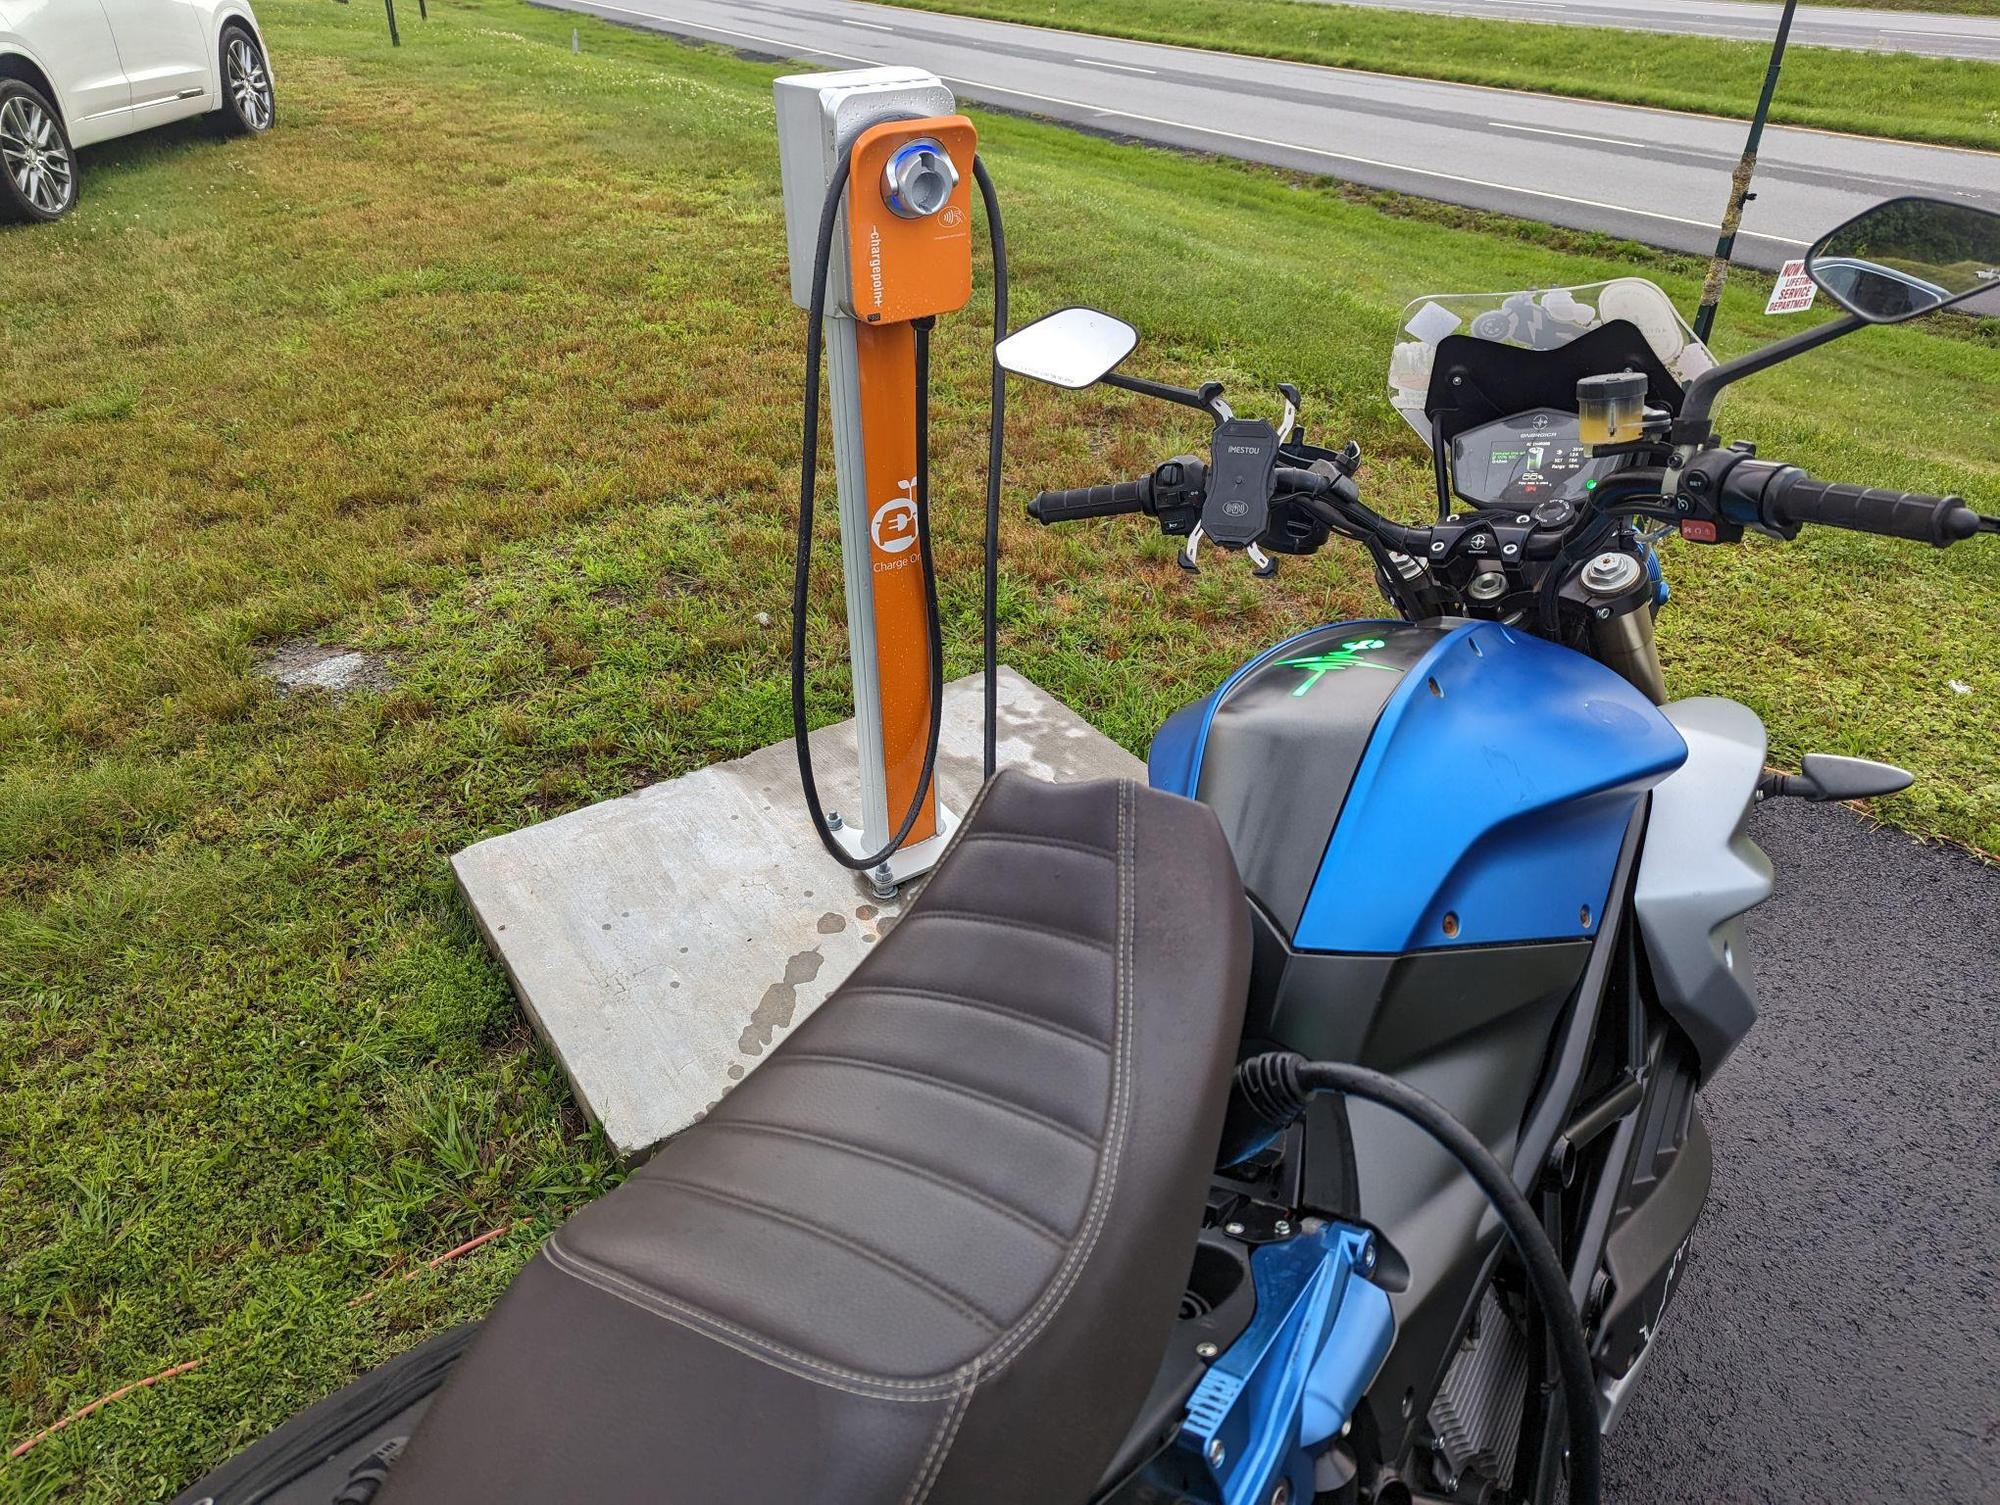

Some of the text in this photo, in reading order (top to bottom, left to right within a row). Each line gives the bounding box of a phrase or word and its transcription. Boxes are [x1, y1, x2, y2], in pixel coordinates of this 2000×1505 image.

[1779, 286, 1812, 300] SERVICE
[1768, 297, 1812, 312] DEPARTMENT
[873, 556, 908, 573] Charge
